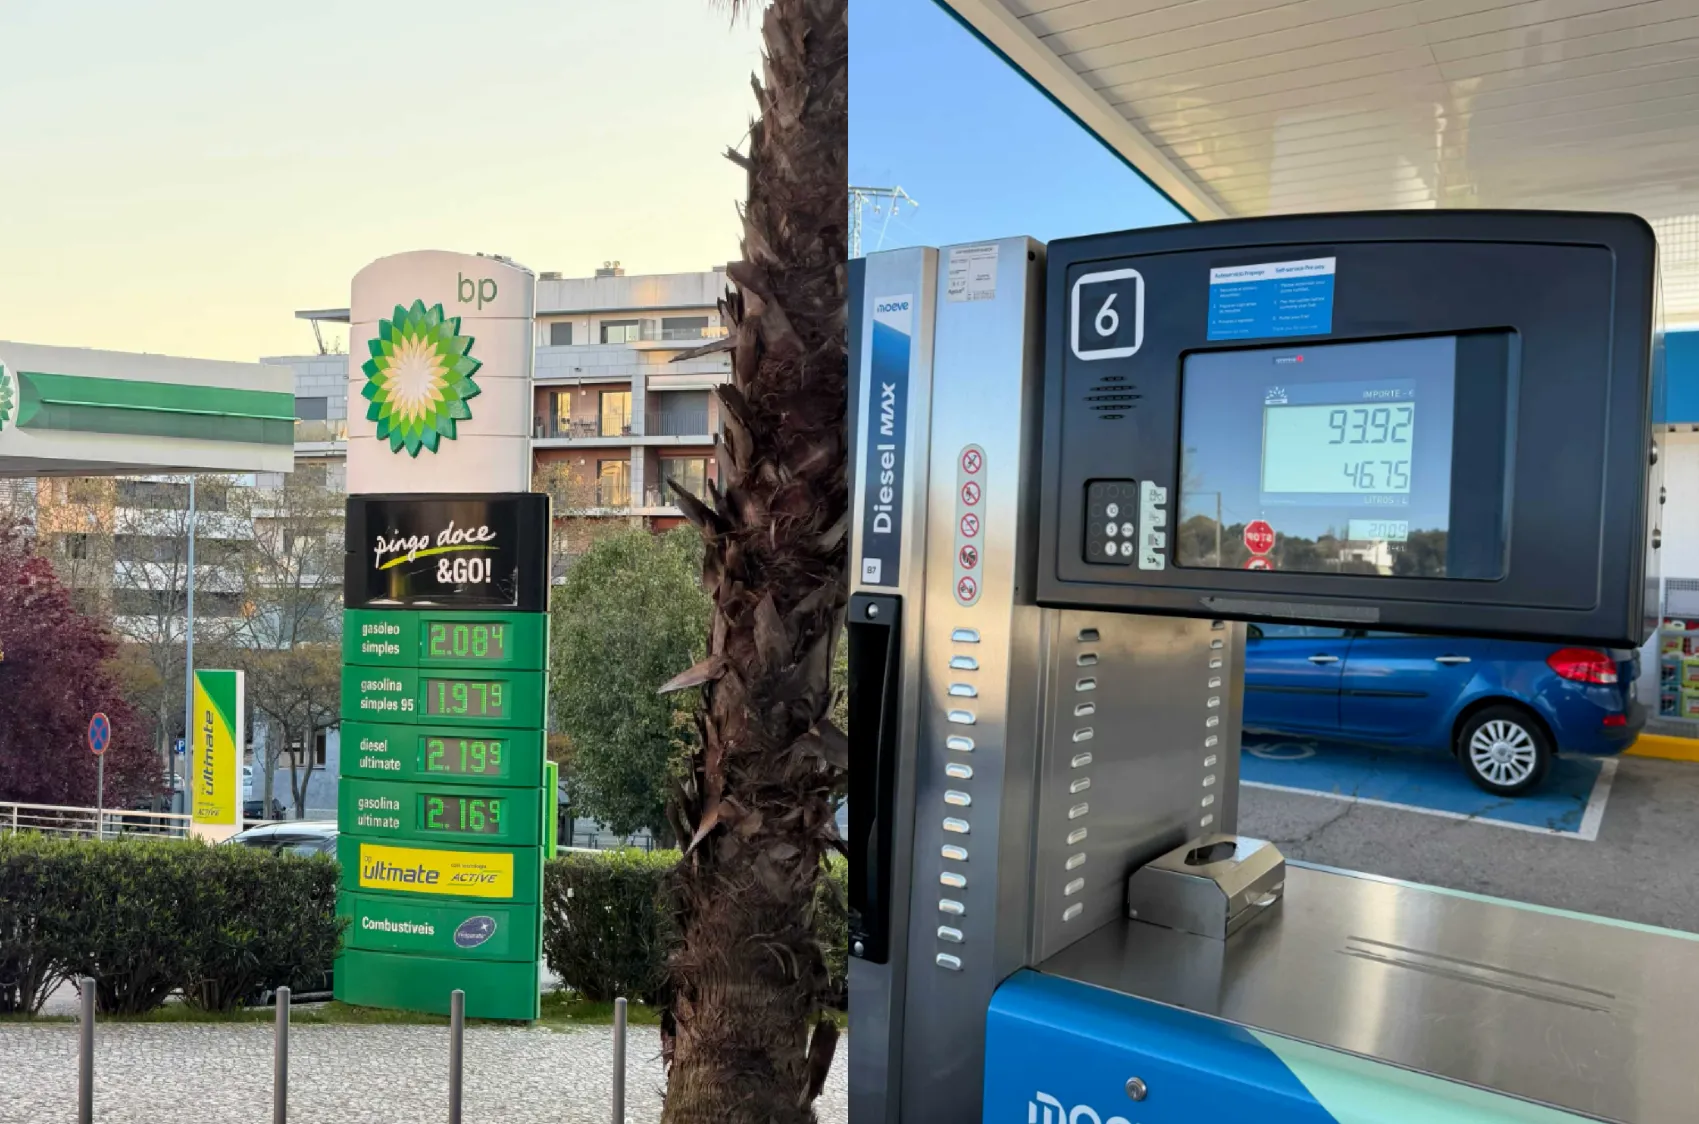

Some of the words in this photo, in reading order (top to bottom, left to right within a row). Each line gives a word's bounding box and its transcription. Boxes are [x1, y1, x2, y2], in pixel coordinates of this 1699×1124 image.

[457, 272, 498, 310] bp
[877, 301, 909, 313] moeve
[1095, 293, 1119, 337] 6
[880, 382, 896, 436] MAX
[1328, 407, 1413, 444] 93.92
[873, 444, 896, 534] Diesel
[374, 529, 430, 569] pingo
[436, 520, 498, 546] doce
[437, 558, 492, 583] &GO!
[867, 566, 877, 575] B7
[361, 640, 400, 657] simples
[361, 678, 402, 693] gasolina
[360, 696, 398, 713] simples
[401, 698, 414, 712] 95
[203, 710, 214, 796] ultimate
[360, 738, 388, 752] diesel
[360, 756, 401, 770] ultimate
[358, 797, 400, 812] gasolina
[358, 814, 400, 829] ultimate
[363, 860, 440, 885] ultimate
[450, 873, 498, 884] ACTIVE
[362, 916, 435, 935] Combustíveis
